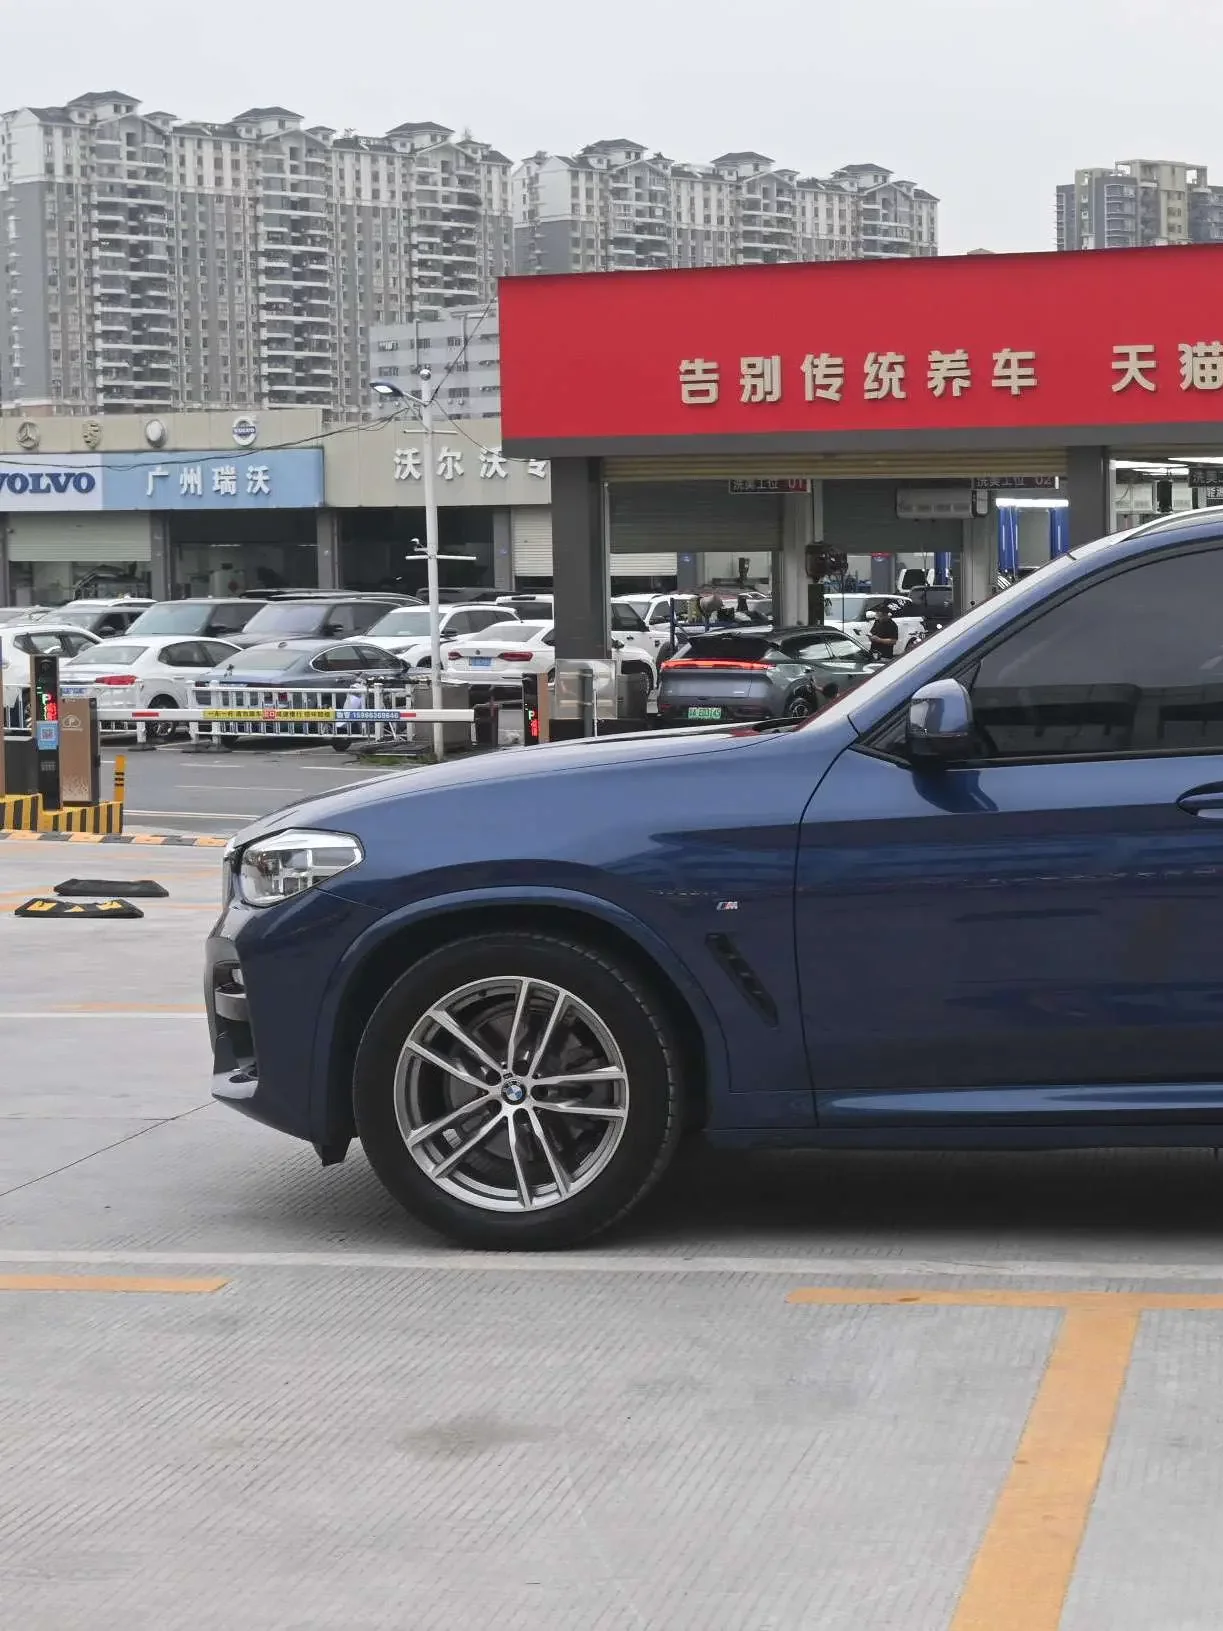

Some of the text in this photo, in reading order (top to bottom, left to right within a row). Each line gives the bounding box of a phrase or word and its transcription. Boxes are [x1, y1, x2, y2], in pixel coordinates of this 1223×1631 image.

[678, 348, 1038, 405] 告别传统养车
[146, 464, 272, 497] 广州瑞沃
